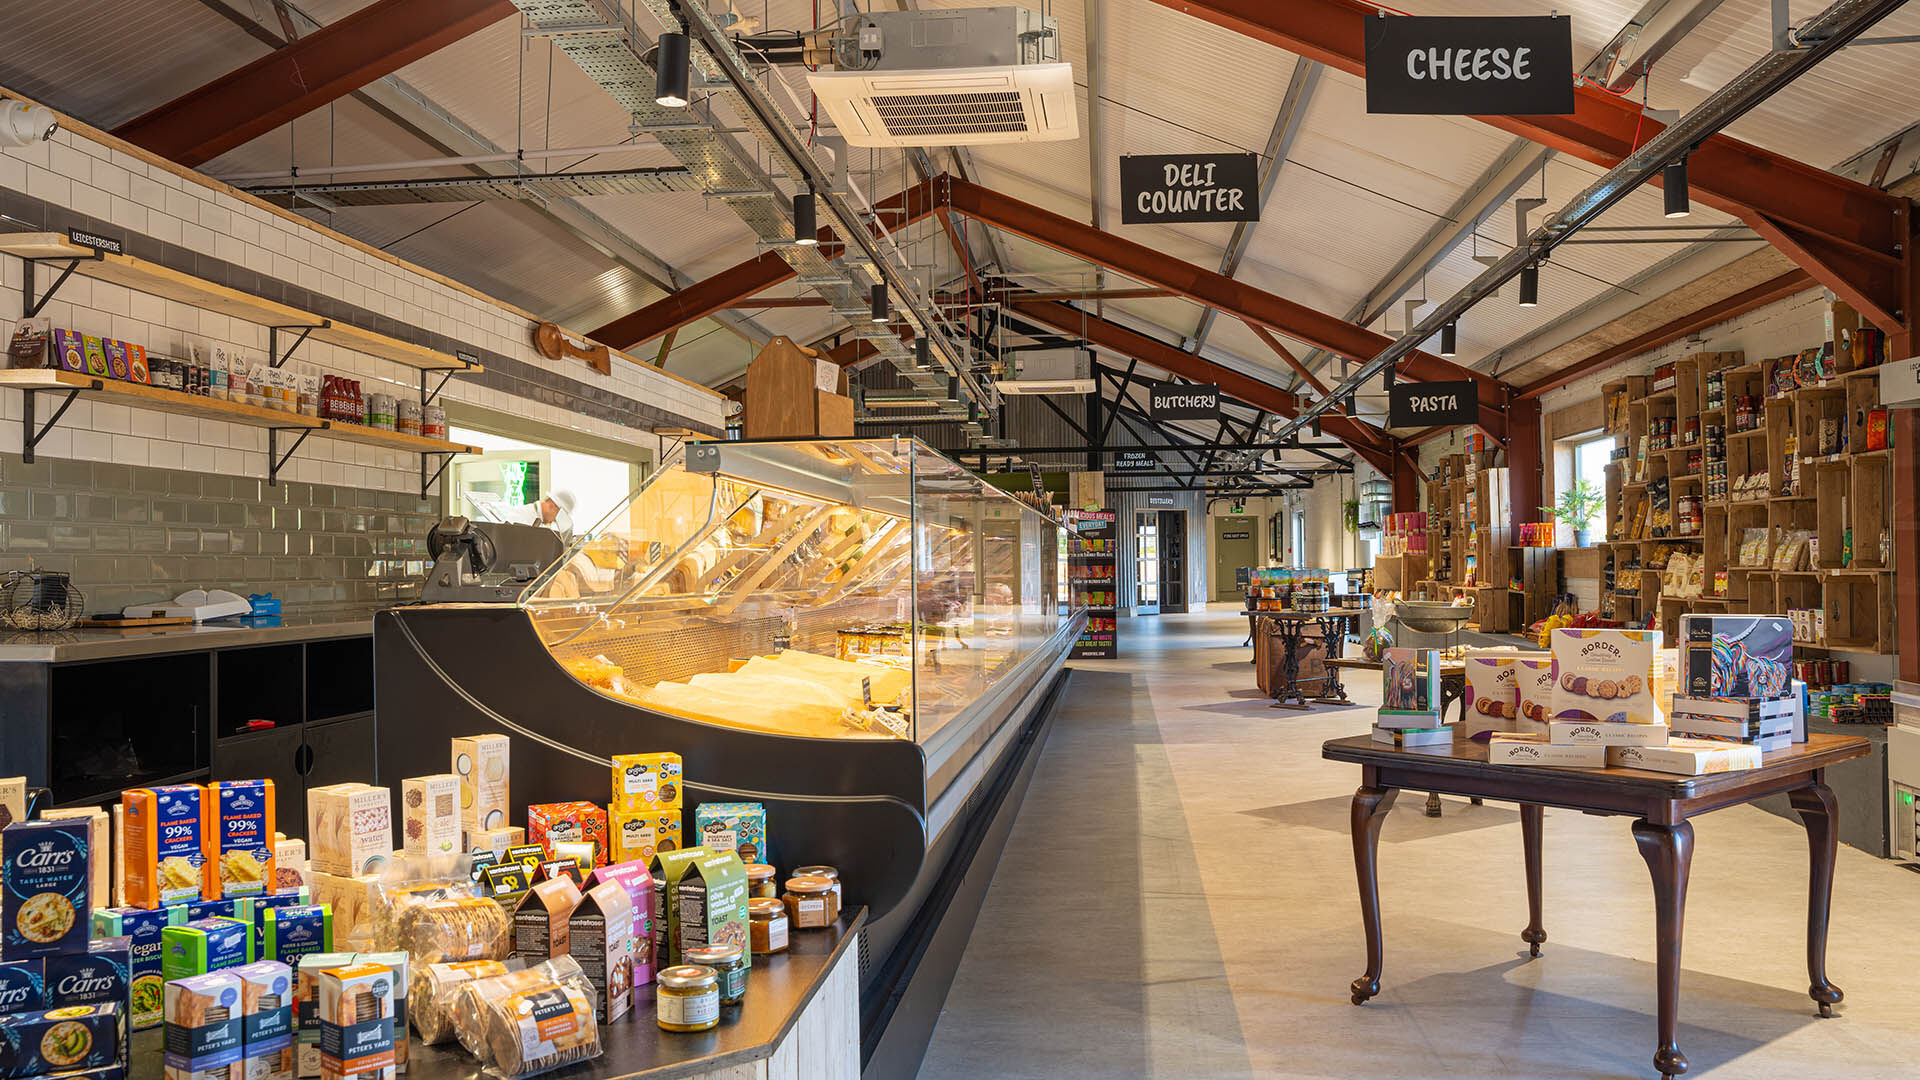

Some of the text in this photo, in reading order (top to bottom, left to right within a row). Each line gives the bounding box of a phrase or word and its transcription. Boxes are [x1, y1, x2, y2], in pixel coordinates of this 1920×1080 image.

[1406, 47, 1532, 82] CHEESE
[1163, 162, 1217, 188] DELI
[1137, 188, 1244, 214] COUNTER
[72, 232, 120, 251] LEICESTERSHIRE
[1154, 395, 1216, 409] BUTCHERY
[1410, 395, 1458, 413] PASTA
[1079, 520, 1104, 529] EVERYDAY
[1581, 641, 1620, 657] BORDER
[1496, 668, 1515, 684] BOR
[1537, 672, 1552, 686] BOR
[1570, 726, 1601, 738] BORDER
[1508, 746, 1540, 758] BORDER
[1619, 748, 1644, 762] BORDER
[165, 826, 192, 838] 99%
[228, 820, 256, 832] 99%
[164, 836, 193, 844] CRACKERS
[360, 834, 383, 844] water
[16, 848, 75, 868] Carr's
[38, 866, 55, 874] 1831
[46, 874, 73, 882] WATER
[712, 914, 728, 926] TOAST
[228, 956, 244, 965] BAKED
[58, 974, 115, 995] Carr's
[534, 1002, 570, 1016] PETER'S YARD
[252, 1024, 287, 1038] PETER'S YARD
[197, 1038, 236, 1052] PETER'S YARD
[348, 1039, 391, 1054] PETER'S YARD
